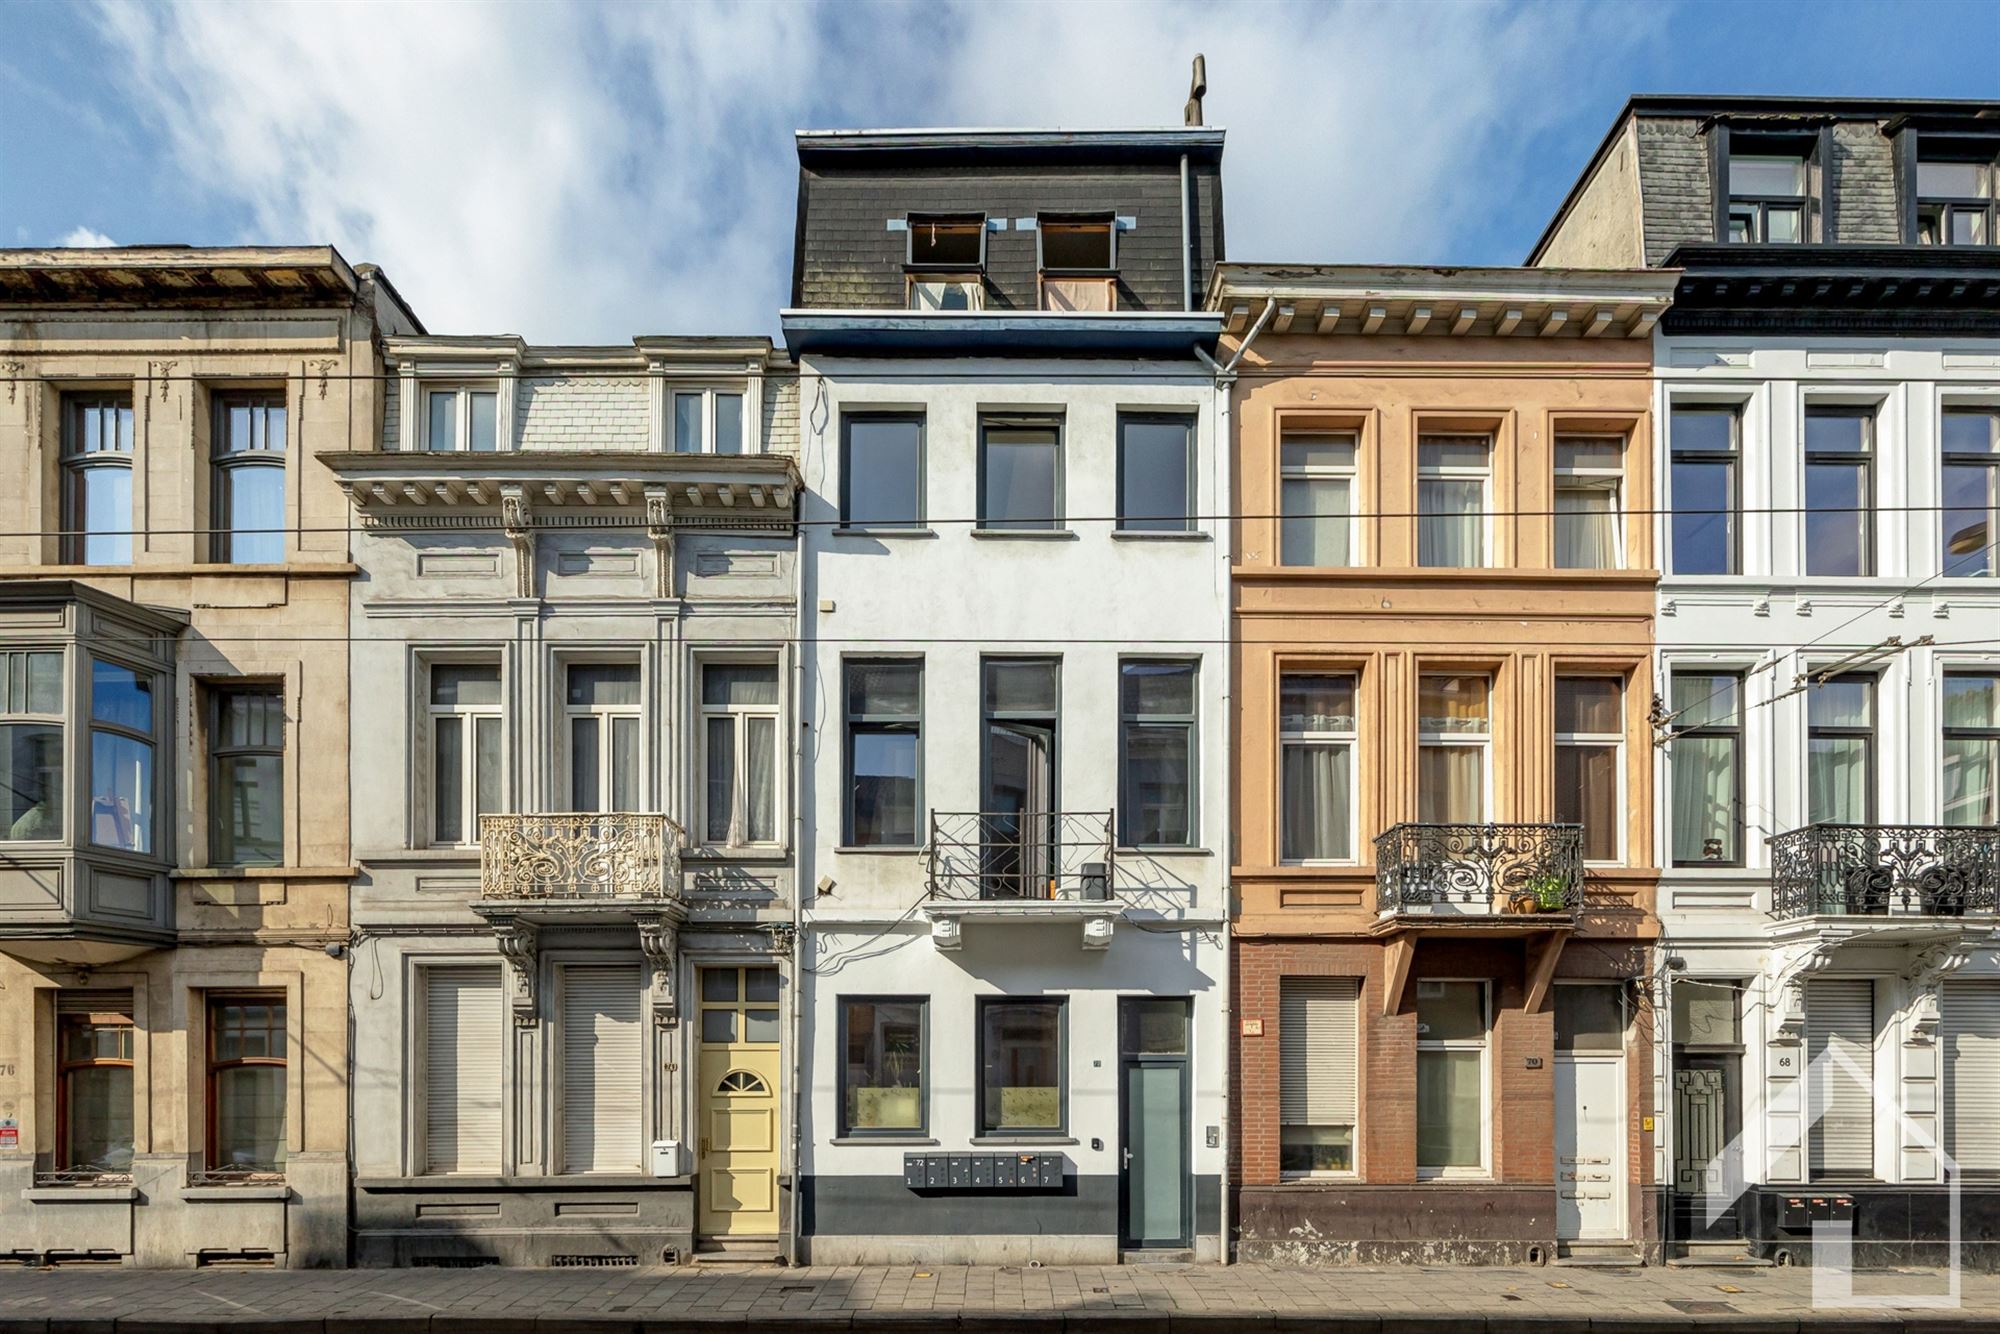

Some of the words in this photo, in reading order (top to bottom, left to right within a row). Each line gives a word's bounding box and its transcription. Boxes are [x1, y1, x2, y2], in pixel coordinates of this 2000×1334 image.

[1780, 1057, 1791, 1066] 68
[0, 1064, 15, 1076] 76
[915, 1159, 924, 1167] 72
[907, 1177, 911, 1185] 1
[998, 1176, 1003, 1184] 5
[1020, 1176, 1026, 1184] 6
[1043, 1176, 1049, 1184] 7
